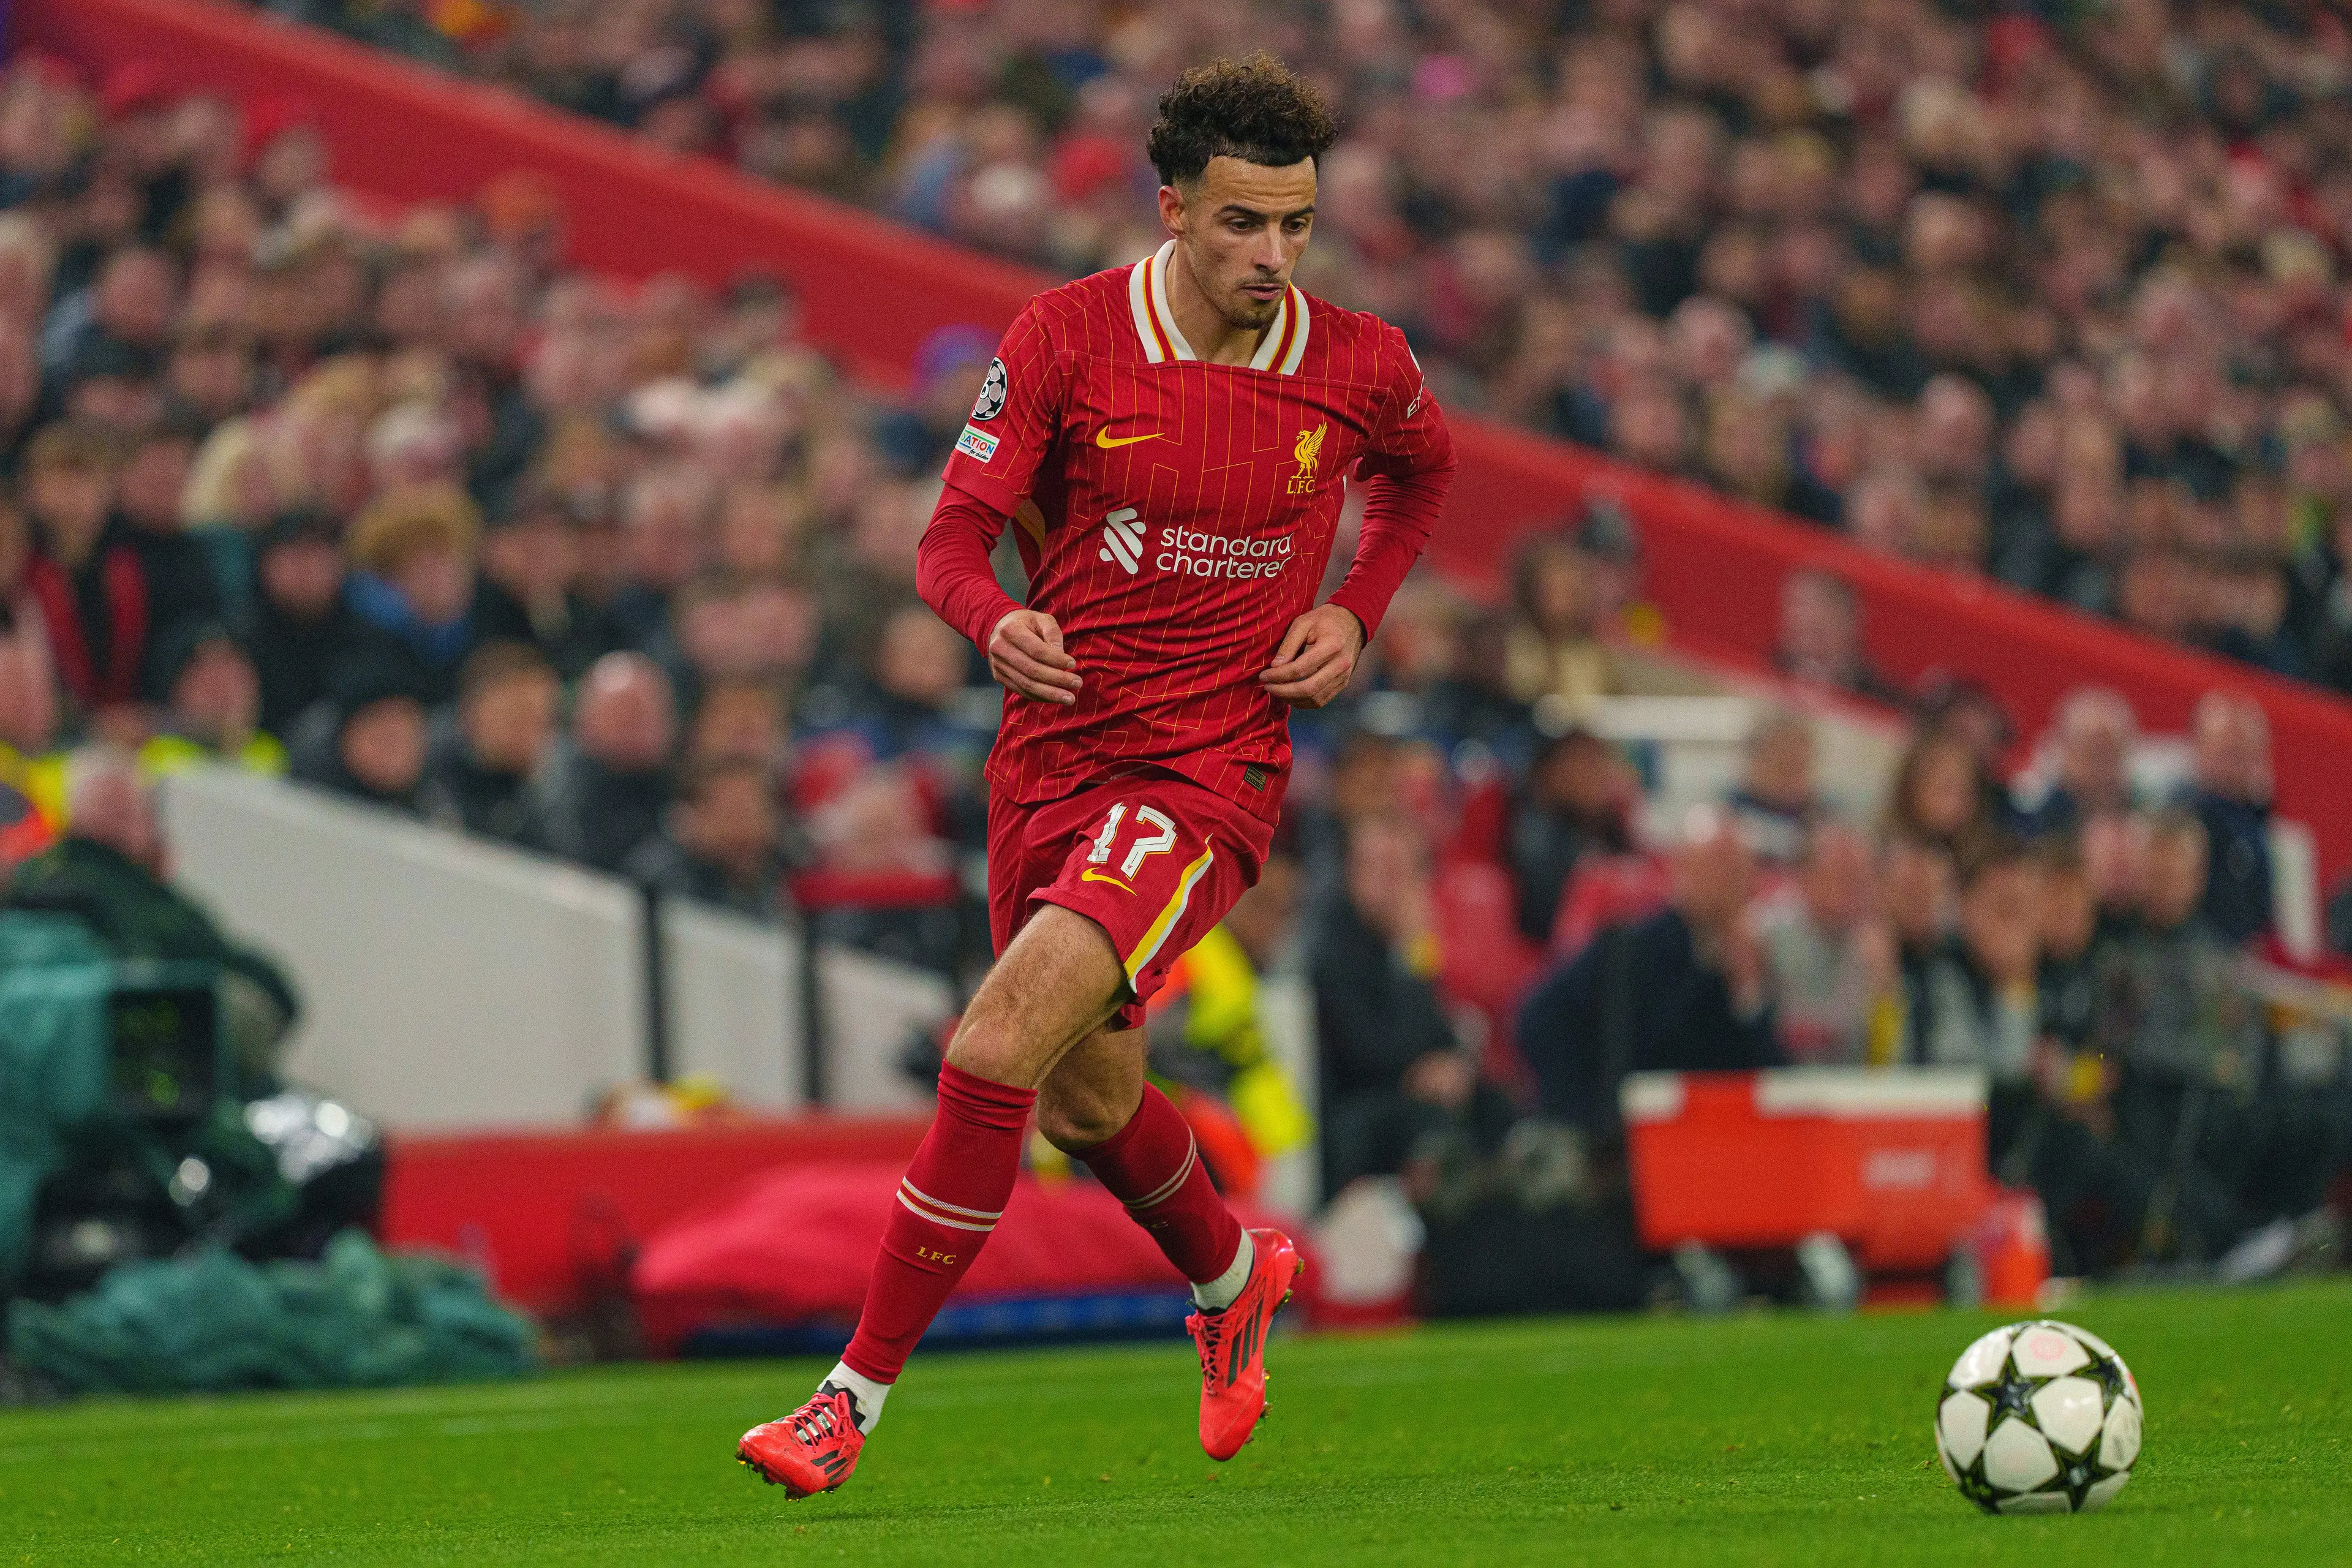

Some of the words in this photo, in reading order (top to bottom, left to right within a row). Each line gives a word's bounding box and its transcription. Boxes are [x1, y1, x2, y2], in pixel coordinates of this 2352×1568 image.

[1160, 525, 1295, 557] standard
[1087, 802, 1178, 881] 17
[916, 1246, 956, 1264] LFC
